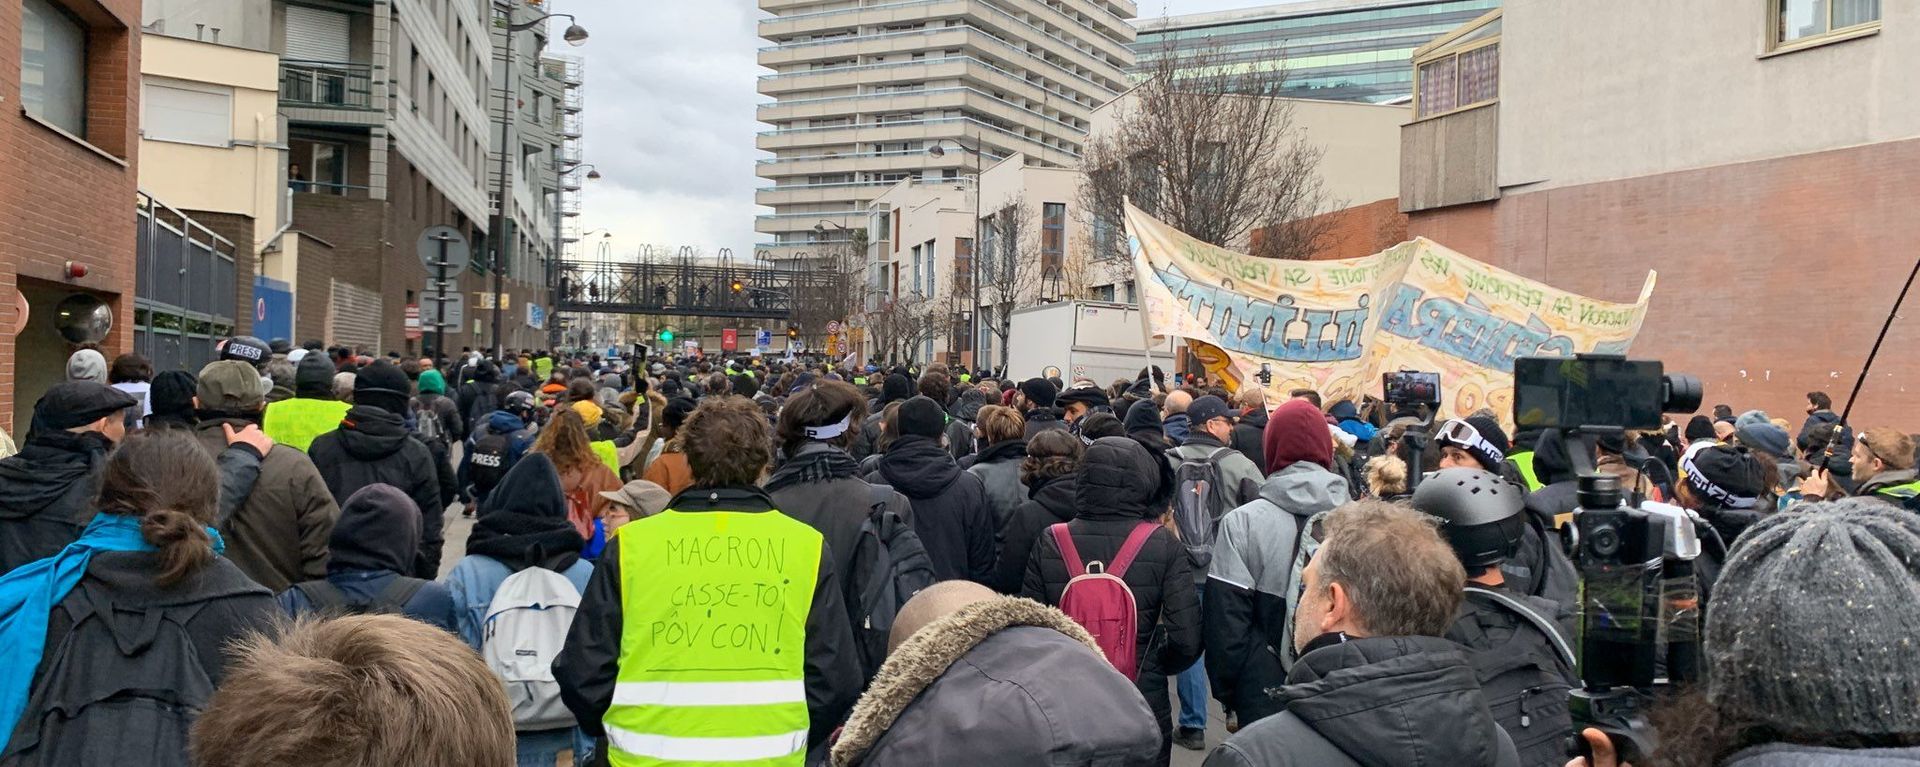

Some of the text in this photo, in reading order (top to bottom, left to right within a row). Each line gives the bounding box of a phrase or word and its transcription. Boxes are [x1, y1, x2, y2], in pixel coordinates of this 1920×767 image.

[230, 344, 261, 359] PRESS
[471, 452, 501, 468] PRESS
[666, 536, 785, 574] MACRON
